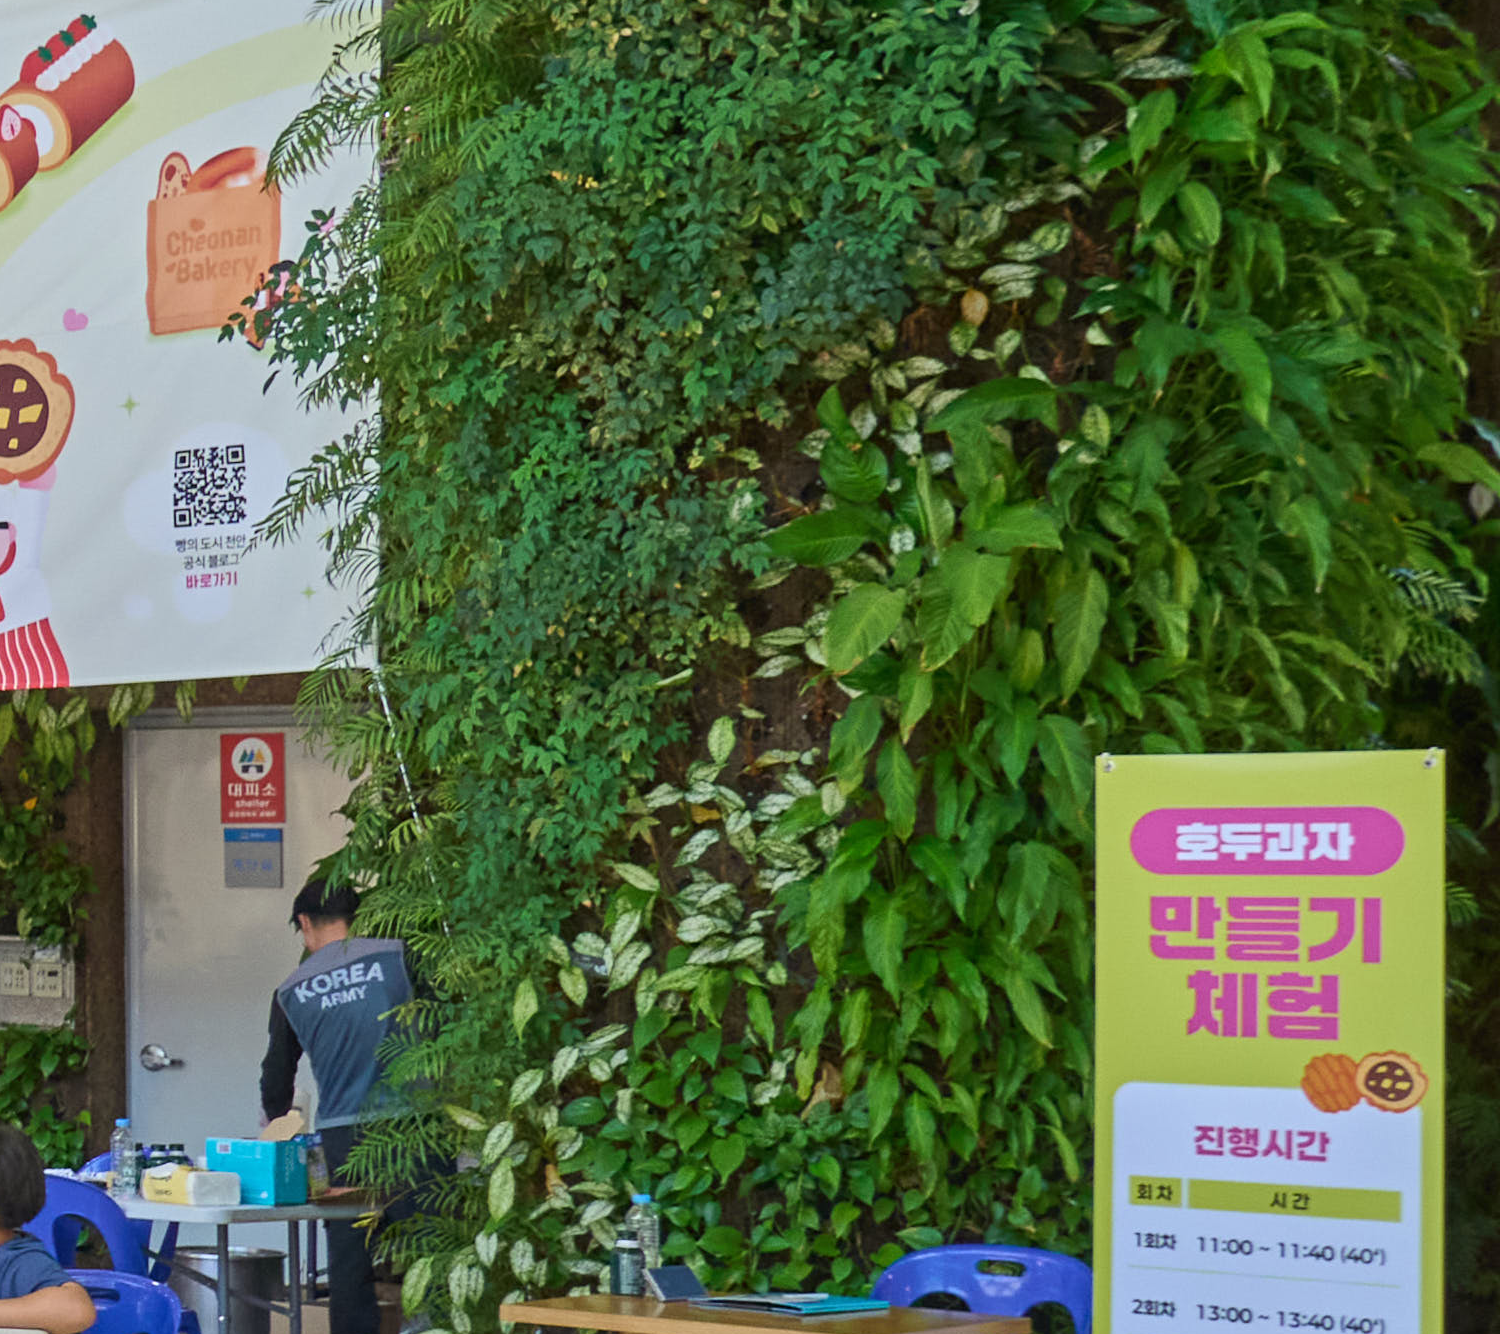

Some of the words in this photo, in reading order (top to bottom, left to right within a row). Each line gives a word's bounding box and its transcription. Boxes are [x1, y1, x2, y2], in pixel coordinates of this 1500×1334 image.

[166, 225, 261, 256] Cheonan
[175, 255, 258, 283] Bakery
[175, 537, 198, 553] 빵의
[201, 536, 223, 550] 도시
[225, 534, 247, 549] 천안
[183, 555, 206, 570] 공식
[208, 553, 240, 568] 블로그
[185, 571, 238, 589] 바로가기
[228, 783, 276, 797] 대피소
[1175, 822, 1355, 861] 호두과자
[1149, 895, 1382, 964] 만들기
[294, 962, 384, 1003] KOREA
[320, 984, 369, 1011] ARMY
[1186, 969, 1339, 1041] 체험
[1194, 1125, 1331, 1163] 진행시간
[1134, 1232, 1177, 1250] 1회차
[1196, 1236, 1253, 1256] 11:00
[1277, 1242, 1335, 1262] 11:40
[1131, 1298, 1176, 1318] 2회차
[1196, 1304, 1253, 1324] 13:00
[1277, 1311, 1335, 1331] 13:40
